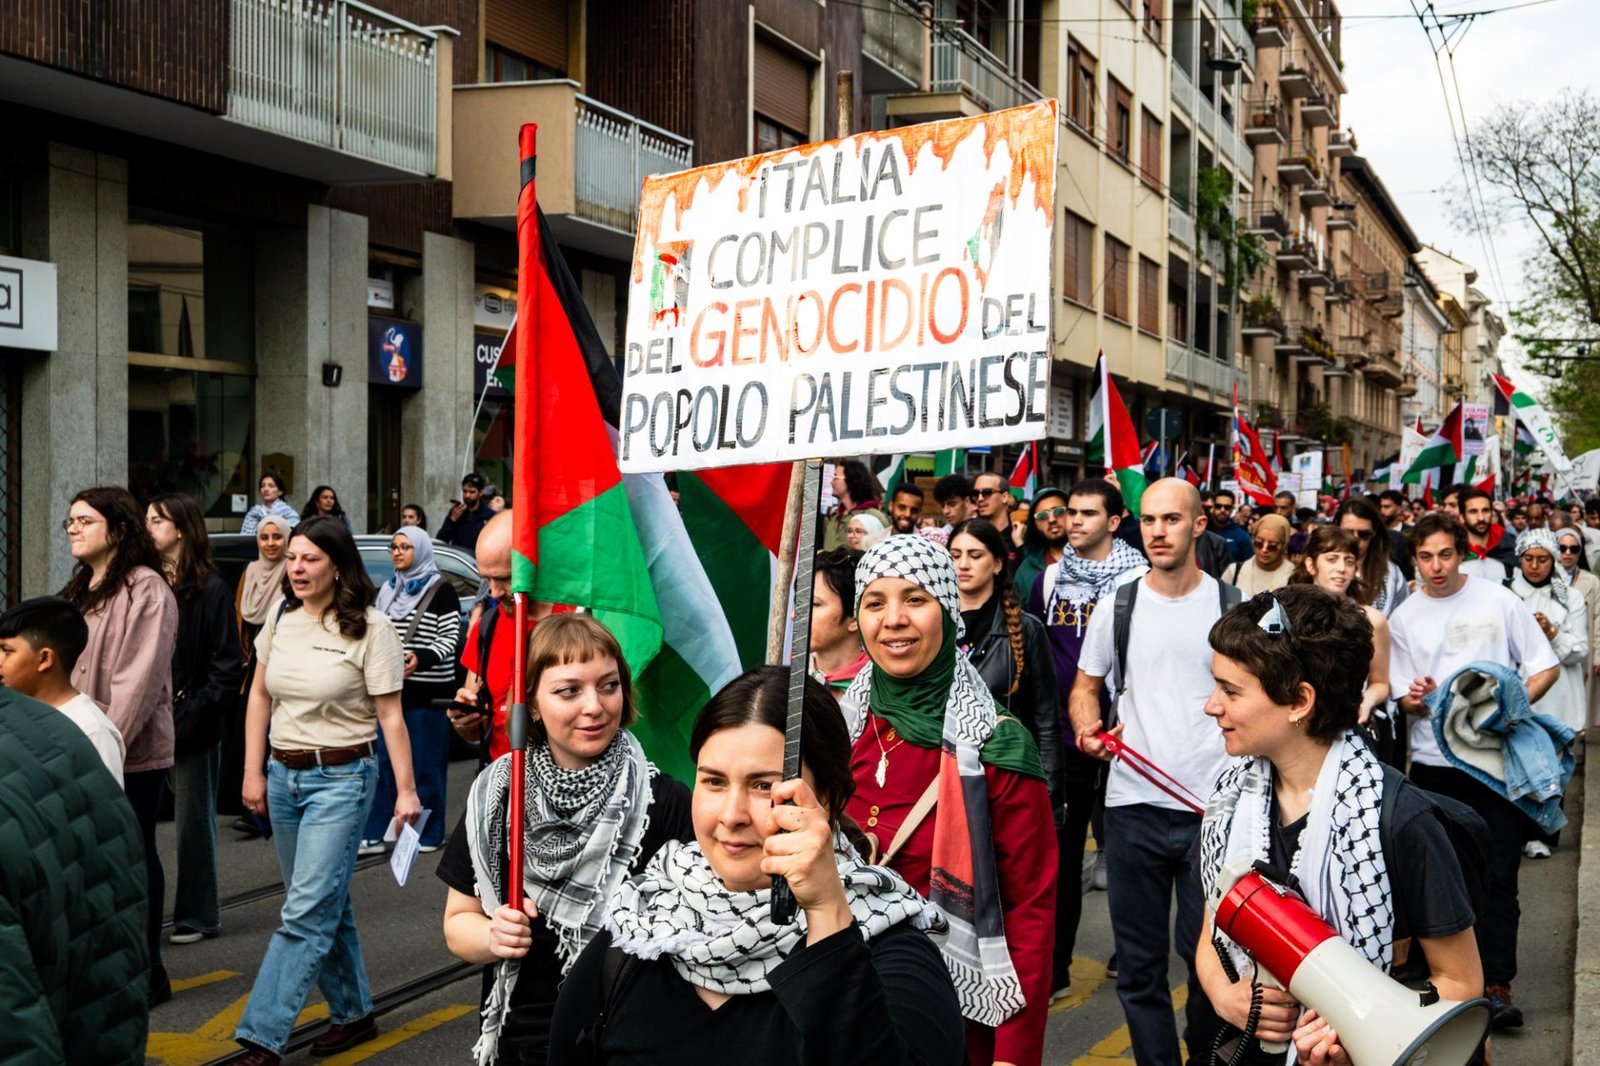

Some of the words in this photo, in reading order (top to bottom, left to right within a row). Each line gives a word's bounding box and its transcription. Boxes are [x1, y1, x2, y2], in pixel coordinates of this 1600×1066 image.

[758, 142, 903, 219] ITALIA
[707, 203, 944, 289] COMPLICE
[627, 337, 682, 378] DEL
[690, 267, 970, 369] GENOCIDIO
[981, 292, 1046, 340] DEL
[622, 380, 769, 461] POPOLO
[788, 350, 1049, 445] PALESTINESE
